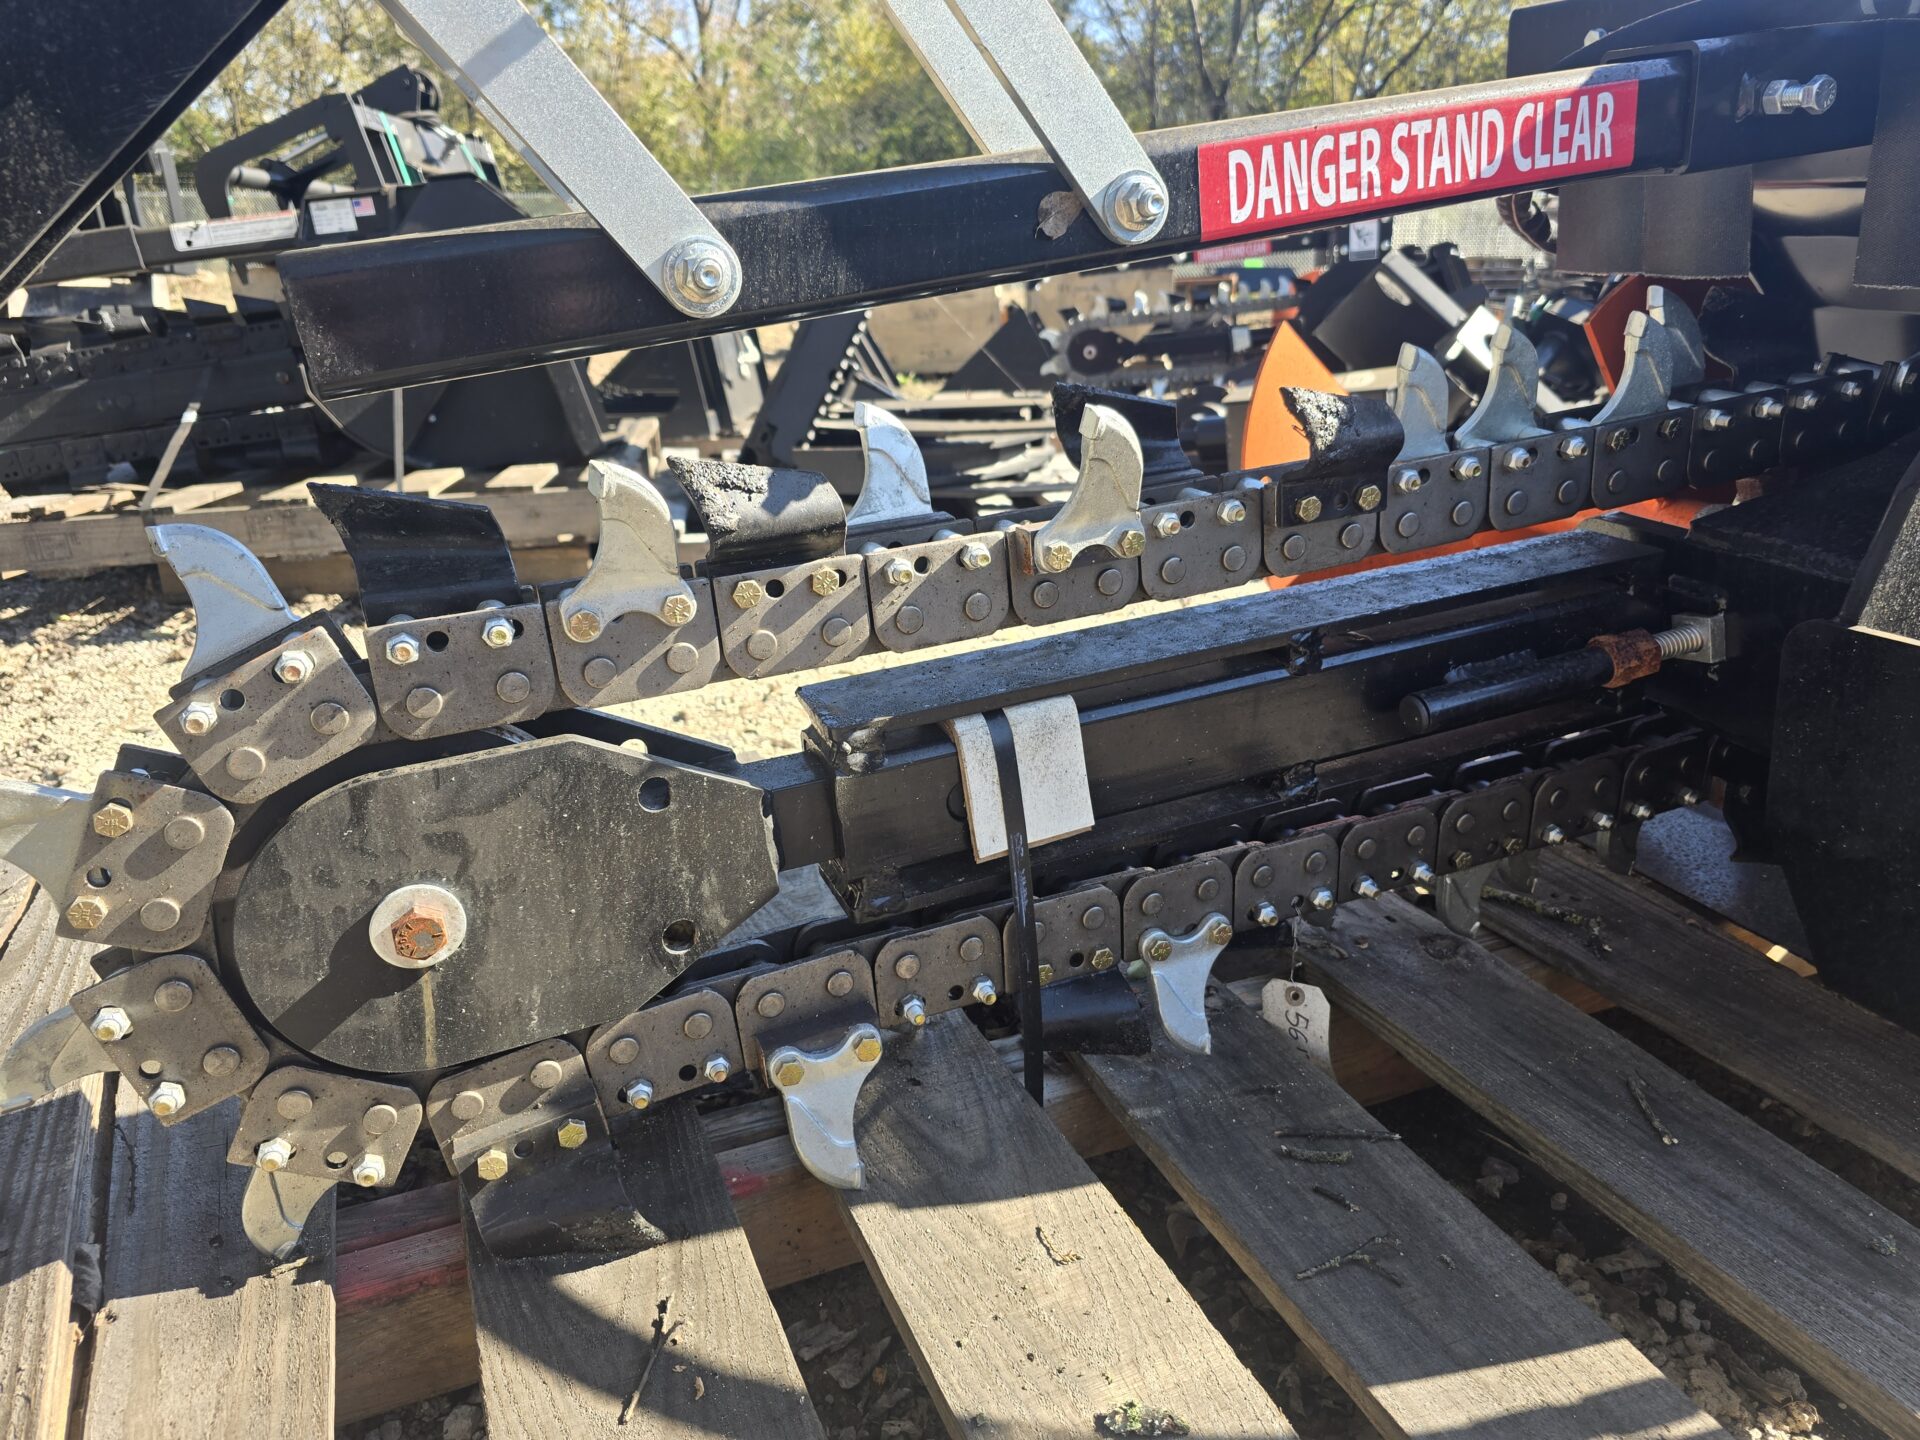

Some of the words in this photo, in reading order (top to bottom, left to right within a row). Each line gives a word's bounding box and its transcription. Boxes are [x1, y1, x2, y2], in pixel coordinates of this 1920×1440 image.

[1228, 128, 1382, 224] DANGER
[1390, 108, 1505, 195] STAND
[1512, 91, 1615, 172] CLEAR
